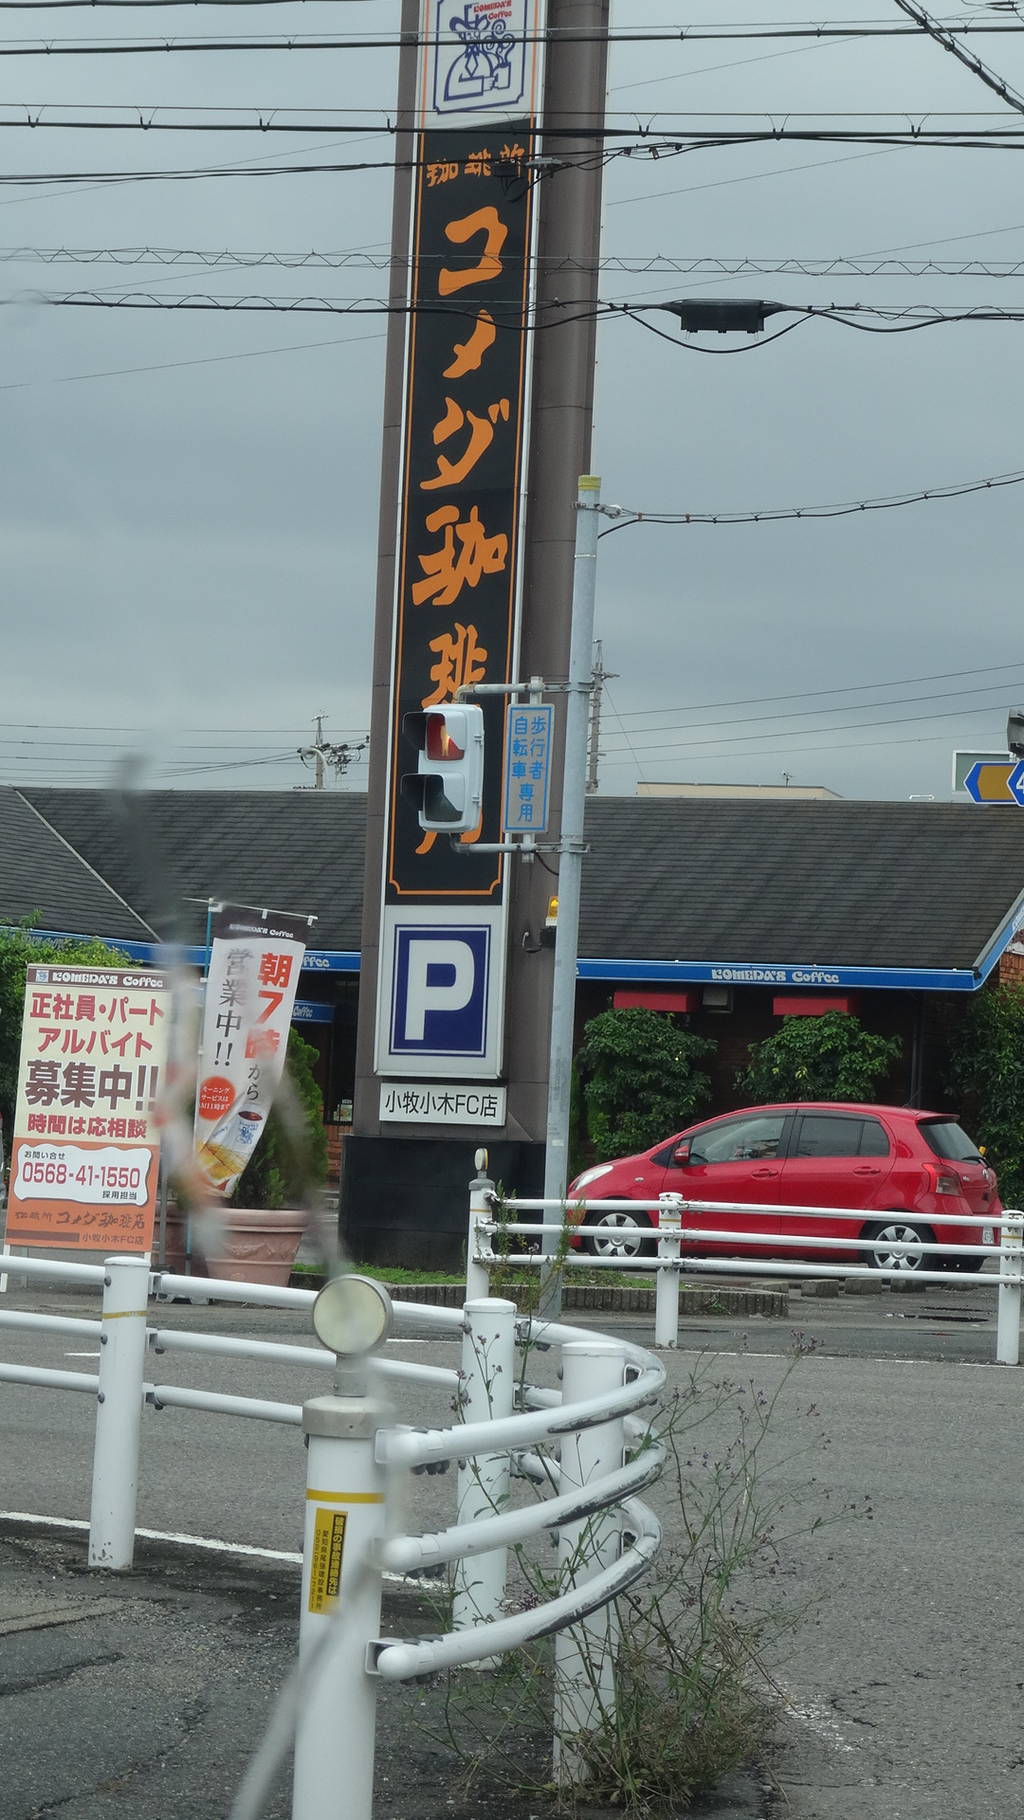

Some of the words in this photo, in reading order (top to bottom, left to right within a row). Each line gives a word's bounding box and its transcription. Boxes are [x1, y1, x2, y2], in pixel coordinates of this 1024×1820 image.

[411, 206, 510, 855] コメダ珈琲
[511, 716, 528, 779] 自転車
[529, 716, 546, 780] 歩行者
[518, 782, 535, 823] 専用
[303, 956, 330, 968] ffee
[711, 969, 786, 981] KOMEDA'S
[792, 971, 840, 983] Coffee
[52, 972, 118, 985] KOMEDA'S
[123, 975, 164, 988] Coffee
[404, 939, 475, 1041] P
[30, 992, 165, 1026] 正社員・パート
[37, 1027, 153, 1058] アルバイト
[25, 1060, 160, 1112] 募集中!!
[385, 1090, 498, 1118] 小牧小木FC店
[27, 1113, 148, 1138] 時間は応相談
[24, 1151, 66, 1160] お問い合せ
[102, 1190, 138, 1200] 採用担当
[82, 1232, 145, 1245] 小牧小木FC店
